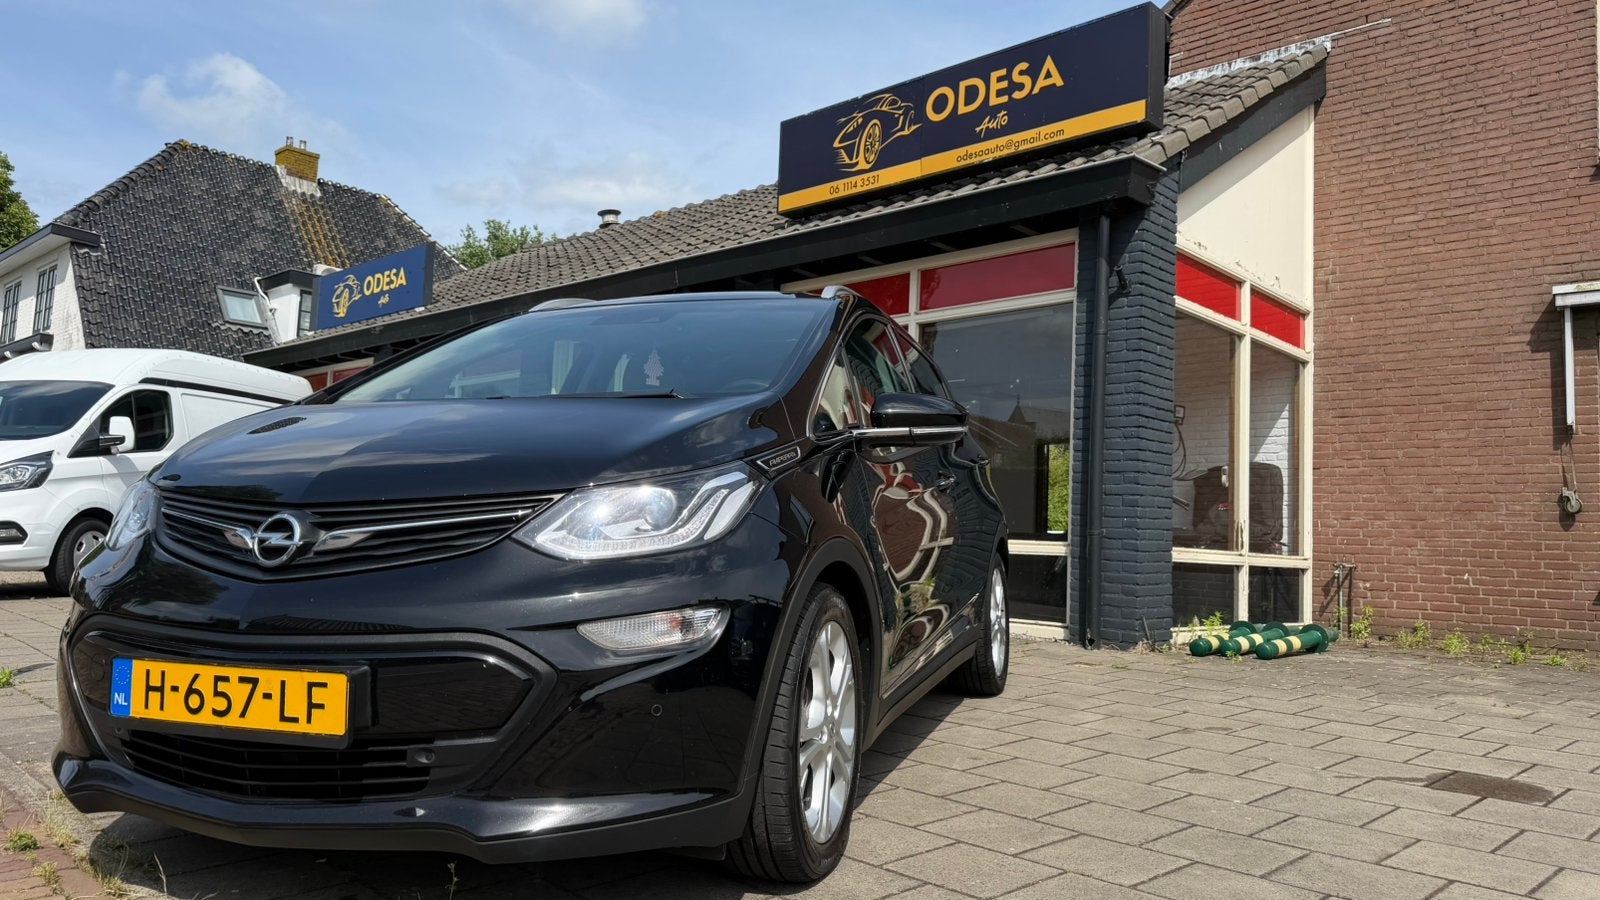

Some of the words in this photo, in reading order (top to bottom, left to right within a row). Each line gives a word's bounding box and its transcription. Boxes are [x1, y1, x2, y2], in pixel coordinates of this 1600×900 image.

[925, 54, 1065, 122] ODESA
[975, 110, 1009, 138] Auto
[956, 128, 1065, 163] odesaauto@gmail.com
[829, 184, 840, 195] 06
[842, 180, 858, 192] 1114
[860, 174, 880, 188] 3531
[363, 266, 407, 296] ODESA
[113, 692, 128, 706] NL
[143, 668, 329, 725] H-657-LF
